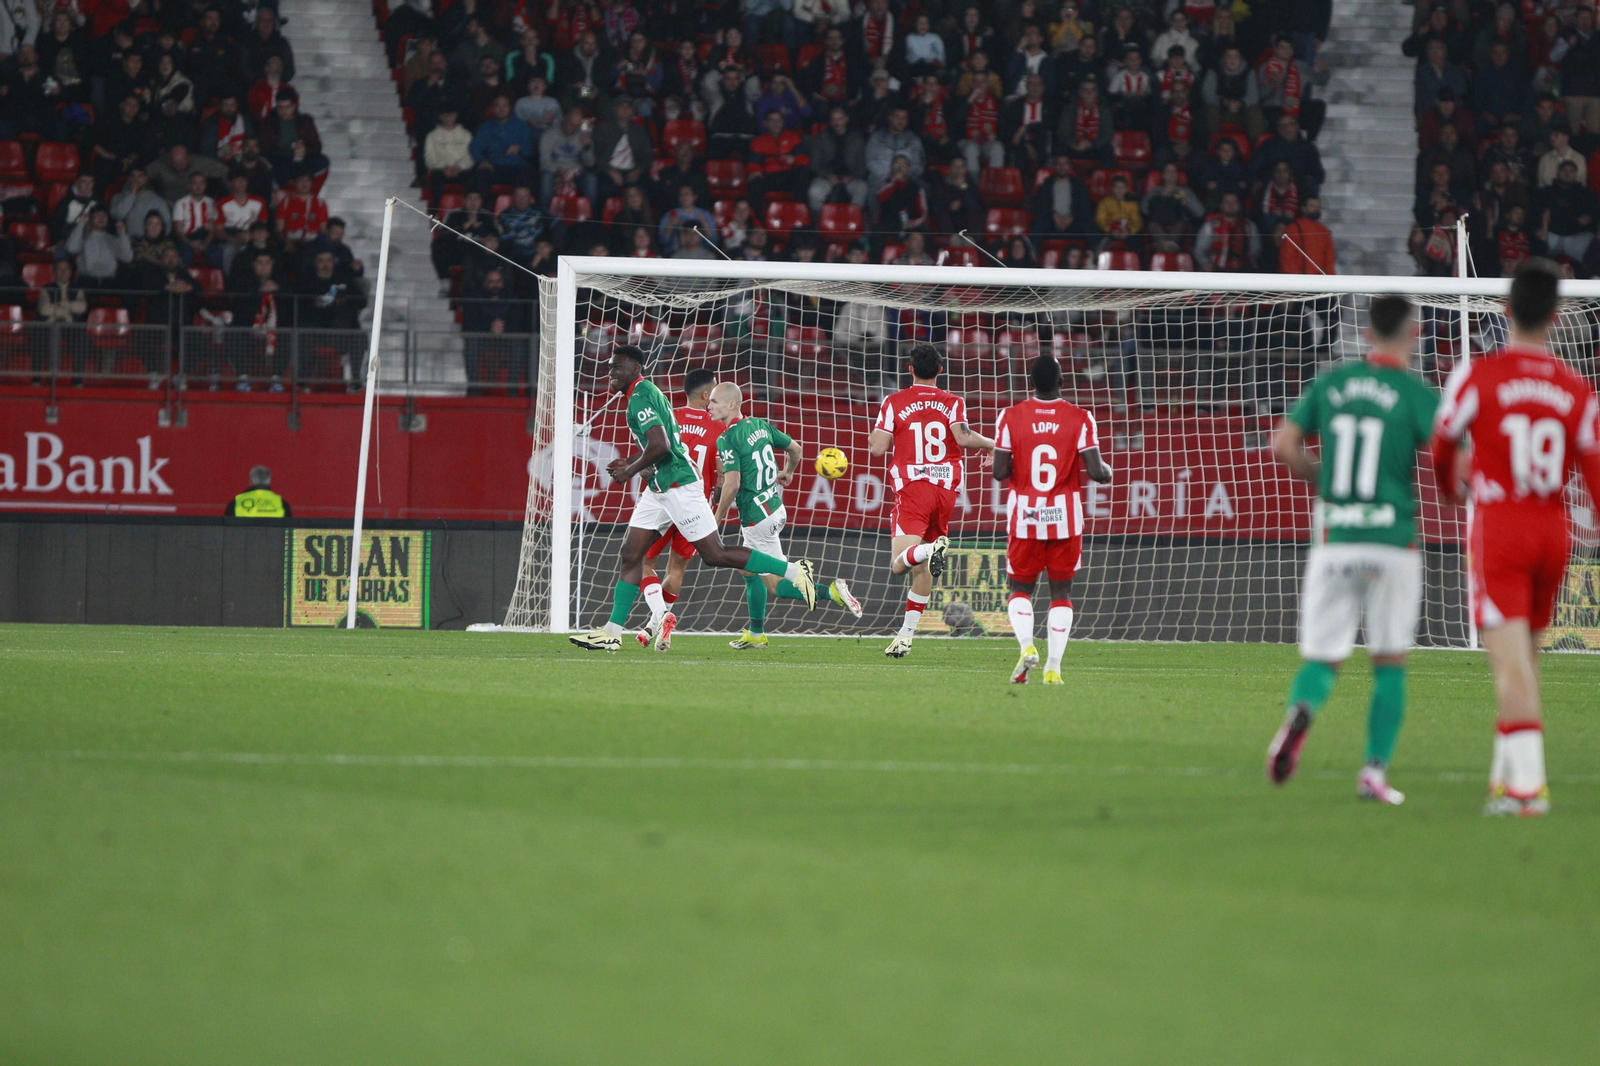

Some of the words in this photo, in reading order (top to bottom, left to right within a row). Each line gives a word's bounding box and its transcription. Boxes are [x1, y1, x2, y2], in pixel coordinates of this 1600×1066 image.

[636, 407, 656, 422] OK
[898, 401, 924, 421] MARC
[1031, 421, 1060, 434] LOPY
[908, 420, 947, 465] 18
[1329, 412, 1386, 501] 11
[1499, 412, 1567, 499] 19
[0, 431, 174, 495] aBank
[751, 443, 778, 491] 18
[1031, 443, 1058, 492] 6
[1040, 507, 1063, 516] POWER
[1040, 514, 1063, 523] HORSE
[304, 578, 328, 602] DE
[336, 579, 409, 602] CBRAS
